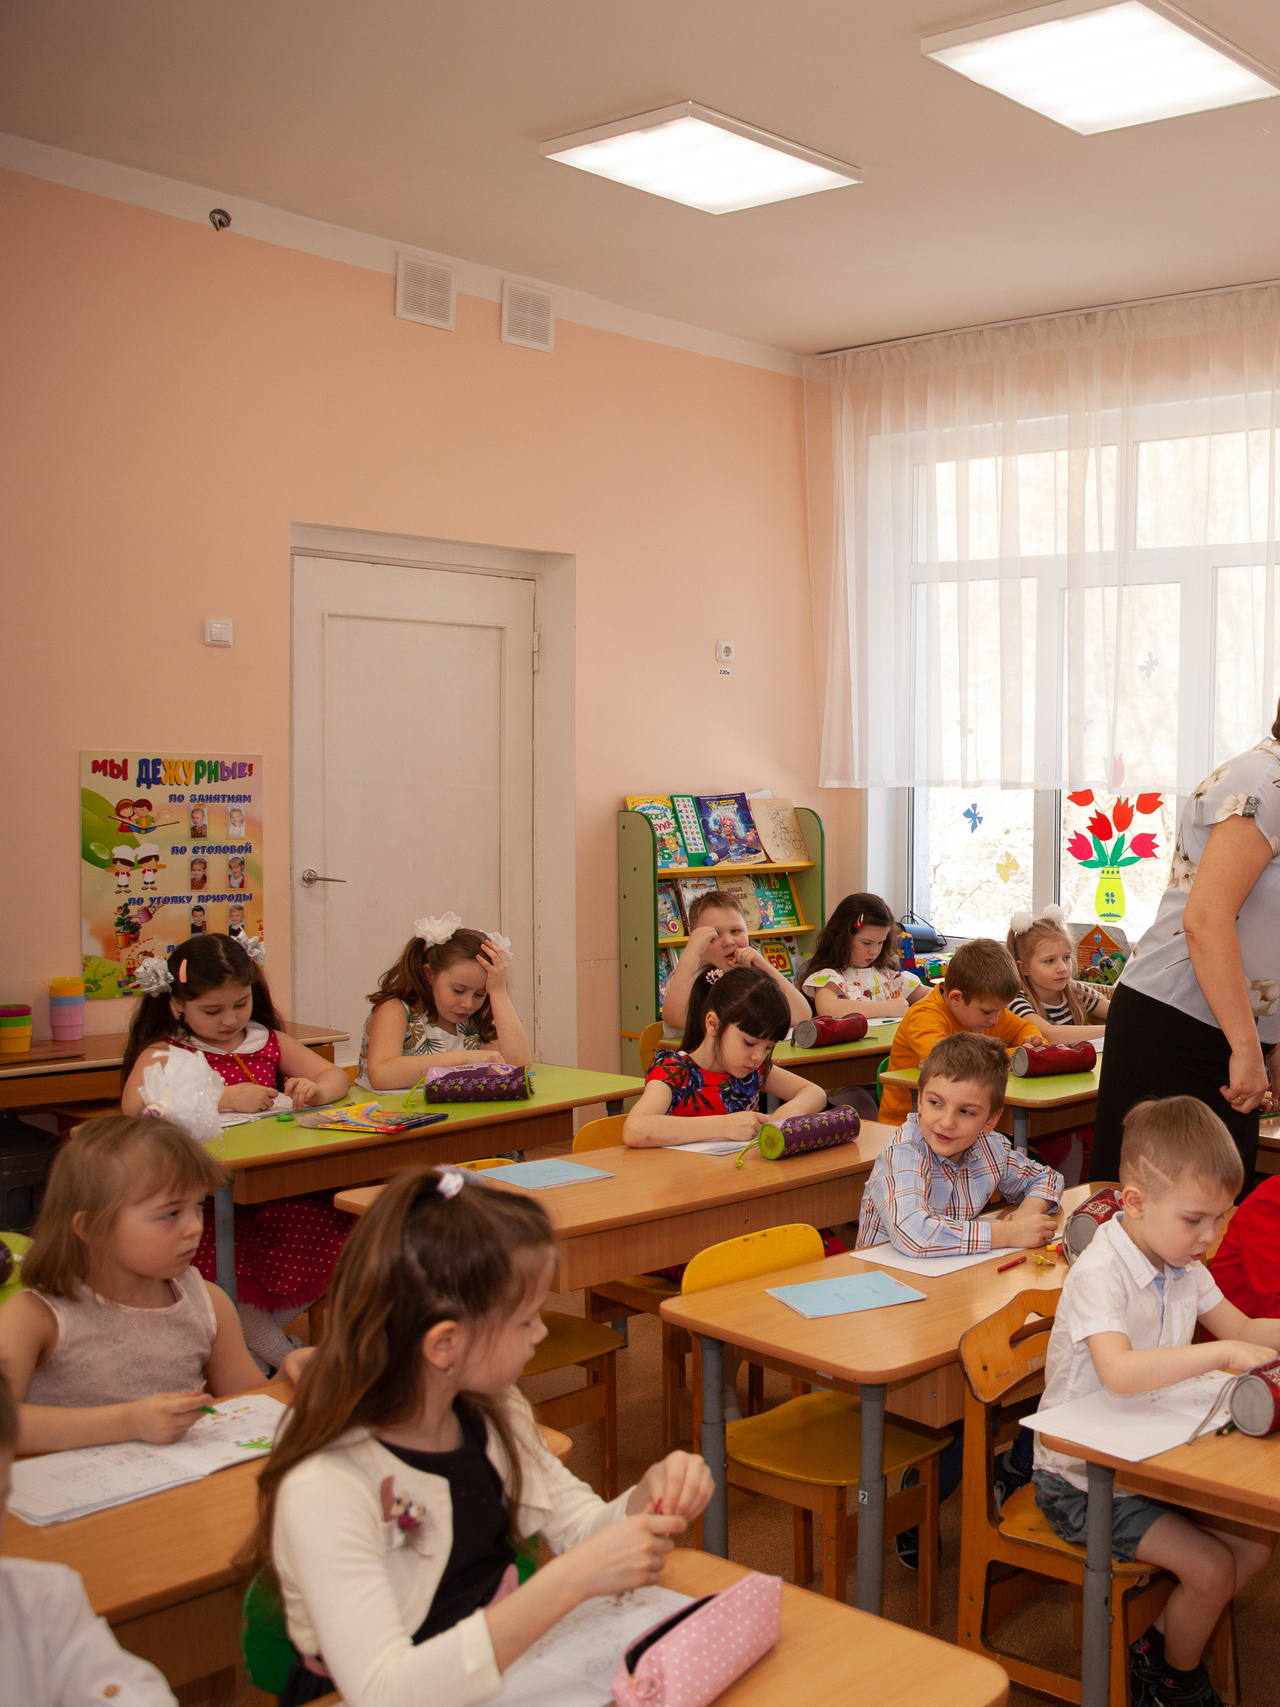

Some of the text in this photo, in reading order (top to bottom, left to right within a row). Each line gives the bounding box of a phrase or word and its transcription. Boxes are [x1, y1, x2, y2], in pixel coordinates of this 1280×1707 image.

[92, 758, 254, 789] МЫ ДЕЖУРНЫЕ!
[168, 794, 252, 804] ПО ЗАНЯТИЯМ
[653, 820, 673, 832] БУКА
[170, 842, 253, 855] ПО СТОЛОВОЙ
[128, 893, 253, 906] ПО УГОЛКУ ПРИРОДЫ
[767, 954, 787, 969] 50
